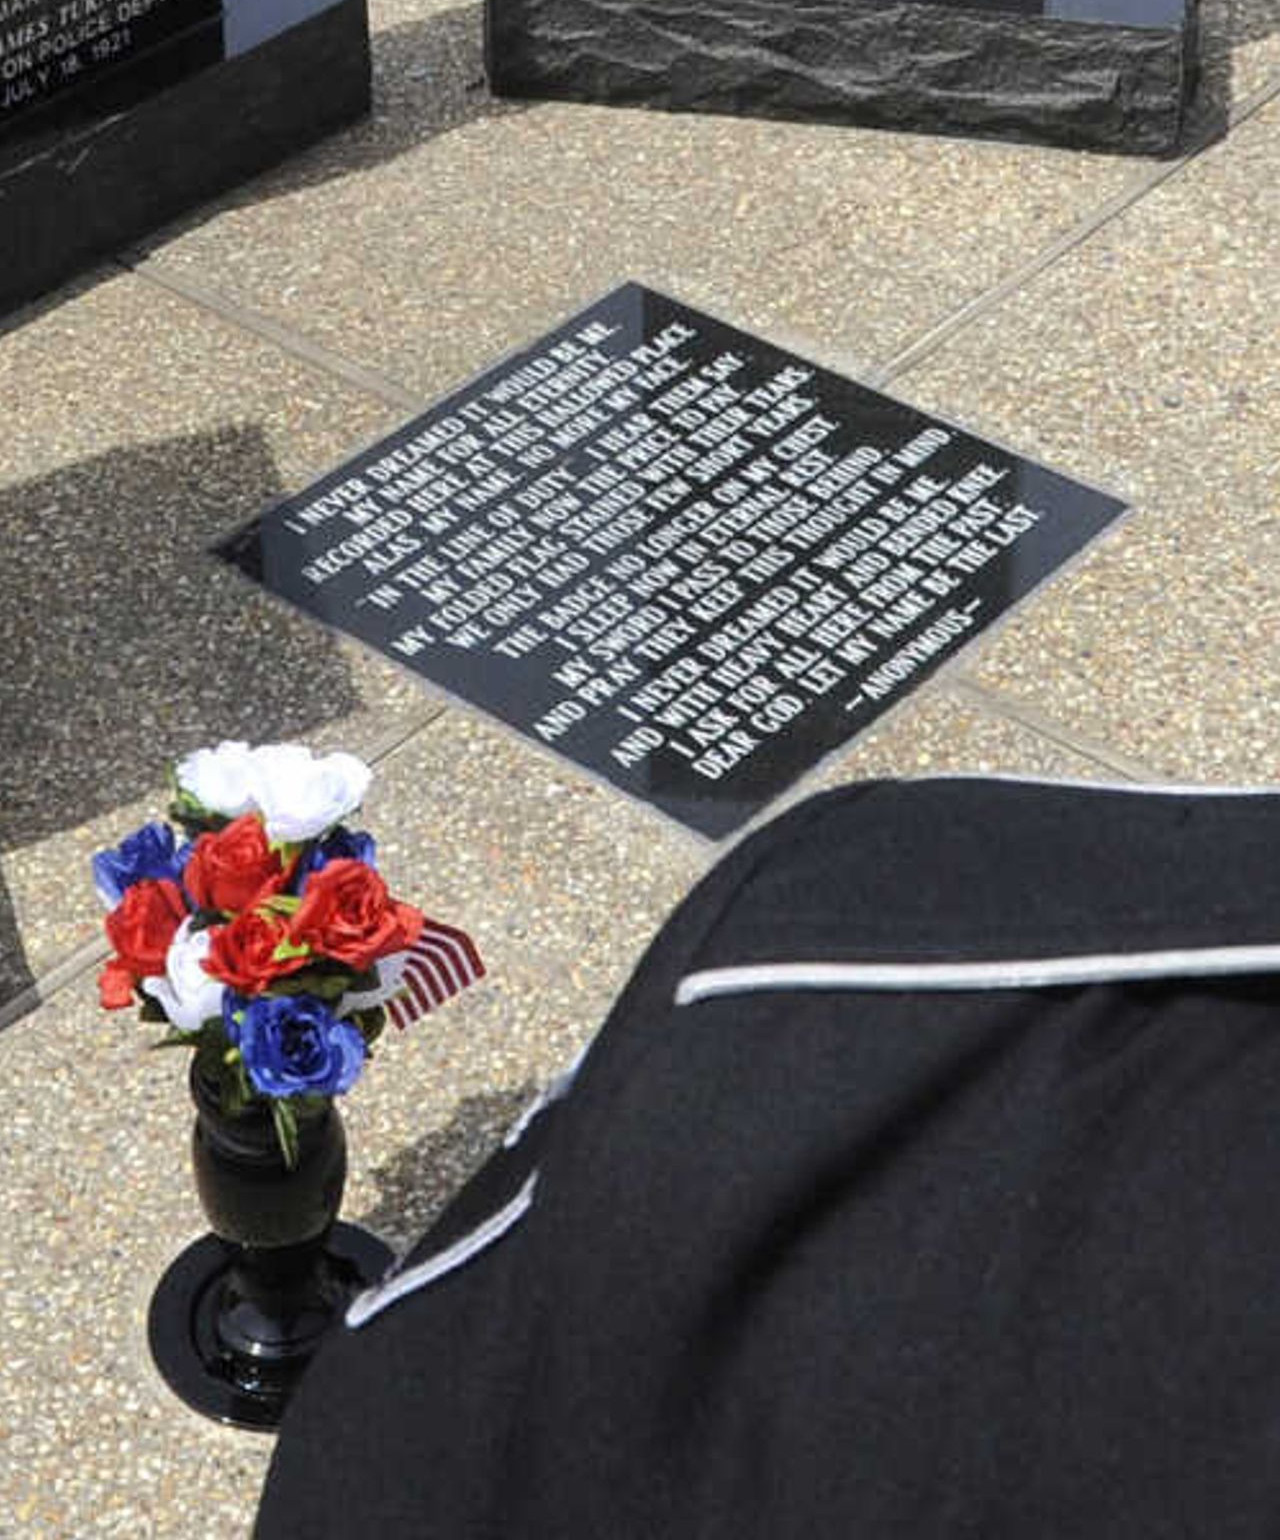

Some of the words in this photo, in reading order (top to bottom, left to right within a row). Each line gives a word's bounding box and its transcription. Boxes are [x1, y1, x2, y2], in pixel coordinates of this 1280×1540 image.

[306, 510, 413, 582] RECORDED
[406, 473, 470, 512] HERE
[465, 453, 496, 477] AT
[489, 423, 544, 456] THIS
[535, 361, 637, 427] HALLOWED
[630, 323, 695, 364] PLACE
[534, 701, 586, 740] AND
[577, 656, 641, 705] PRAY
[633, 616, 697, 660] THEY
[688, 581, 744, 621] KEEP
[738, 546, 794, 582] THIS
[783, 480, 880, 548] THOUGHT
[870, 462, 902, 484] IN
[553, 656, 595, 688] MY
[588, 606, 666, 661] SWORD
[658, 595, 681, 609] I
[671, 560, 729, 599] PASS
[718, 541, 756, 563] TO
[746, 495, 818, 542] THOSE
[611, 727, 663, 768] AND
[654, 682, 722, 727] WITH
[711, 631, 785, 688] HEAVY
[776, 583, 848, 637] HEART
[842, 553, 890, 588] AND
[879, 500, 958, 556] BENDED
[618, 706, 642, 722] I
[630, 658, 707, 711] NEVER
[697, 587, 799, 660] DREAMED
[790, 567, 822, 590] IT
[812, 518, 889, 568] WOULD
[878, 498, 916, 522] BE
